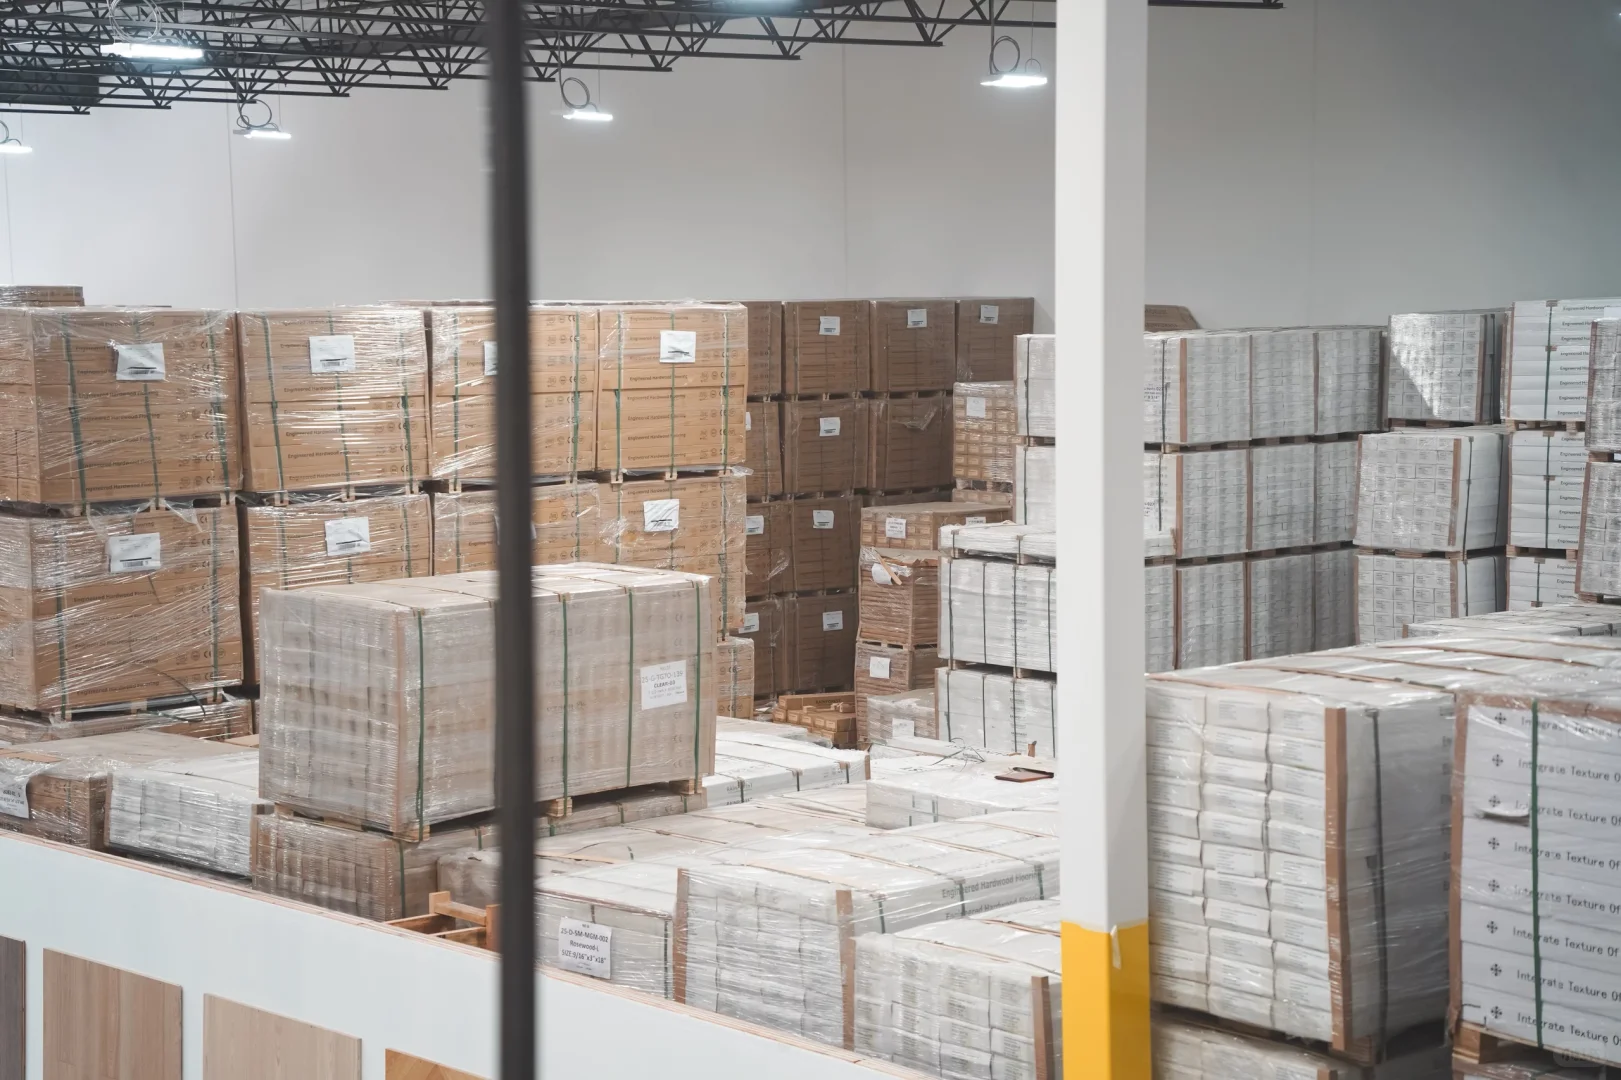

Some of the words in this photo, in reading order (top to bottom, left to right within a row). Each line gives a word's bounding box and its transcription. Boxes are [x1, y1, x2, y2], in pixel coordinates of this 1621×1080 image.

[1571, 766, 1610, 781] Texture
[1568, 808, 1607, 824] Texture
[1514, 841, 1562, 860] Interate
[1567, 851, 1605, 868] Texture
[1609, 859, 1620, 870] Of
[941, 882, 979, 898] Enginered
[980, 875, 1014, 890] Hardwood
[1567, 894, 1605, 912] Texture
[1609, 903, 1621, 914] Of
[1512, 926, 1560, 946] Interate
[1565, 937, 1603, 955] Texture
[1607, 946, 1619, 957] Of
[1516, 969, 1564, 989] Interate
[1569, 980, 1608, 1000] Texture
[1517, 1012, 1565, 1033] Interate
[1570, 1025, 1609, 1044] Texture
